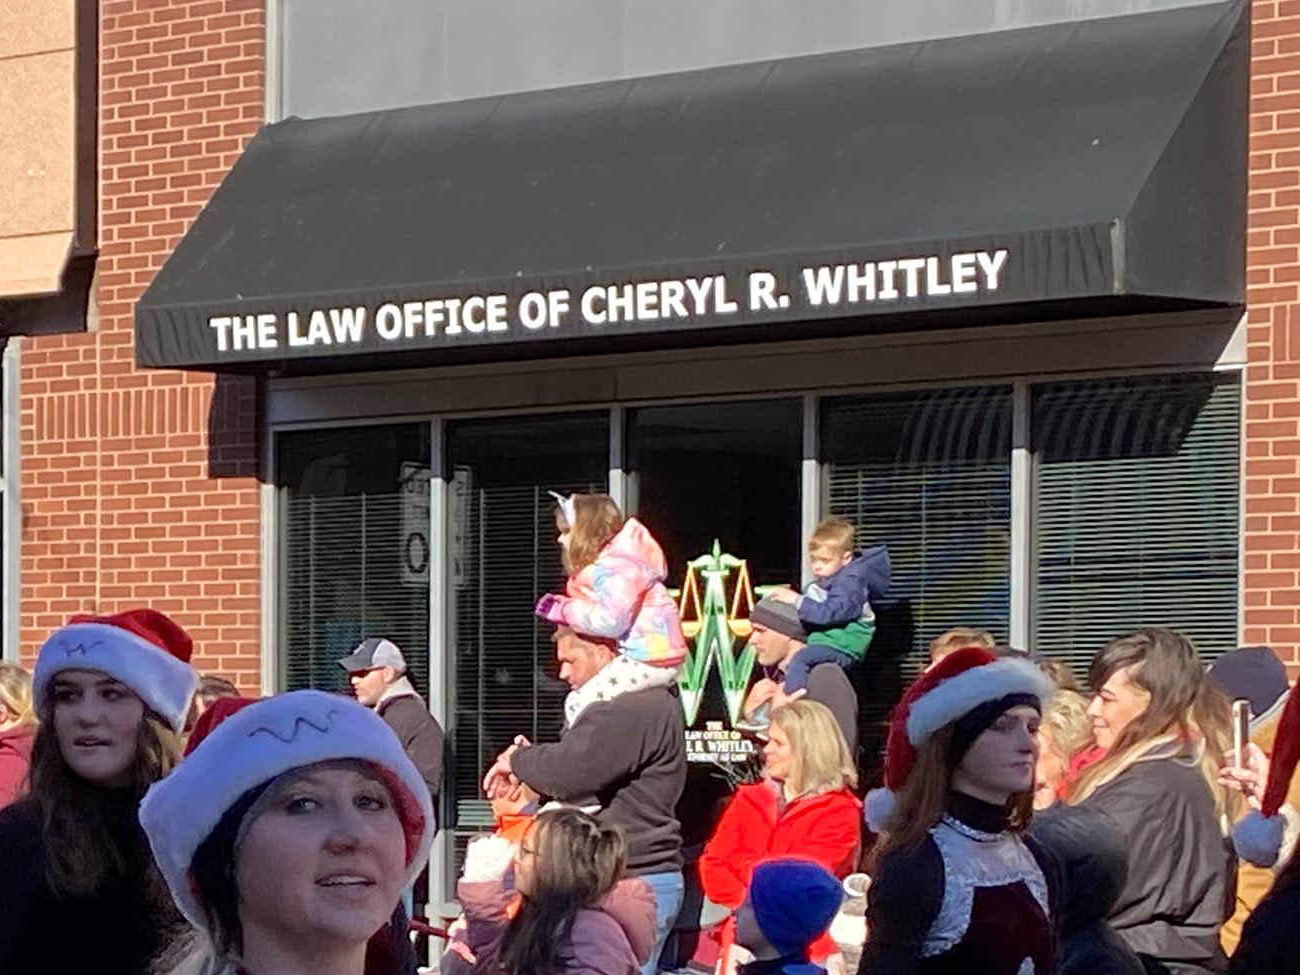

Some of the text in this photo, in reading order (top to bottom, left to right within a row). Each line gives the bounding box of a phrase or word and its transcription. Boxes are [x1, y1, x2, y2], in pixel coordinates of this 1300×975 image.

[210, 250, 1009, 351] THE LAW OFFICE OF CHERYL R. WHITLEY
